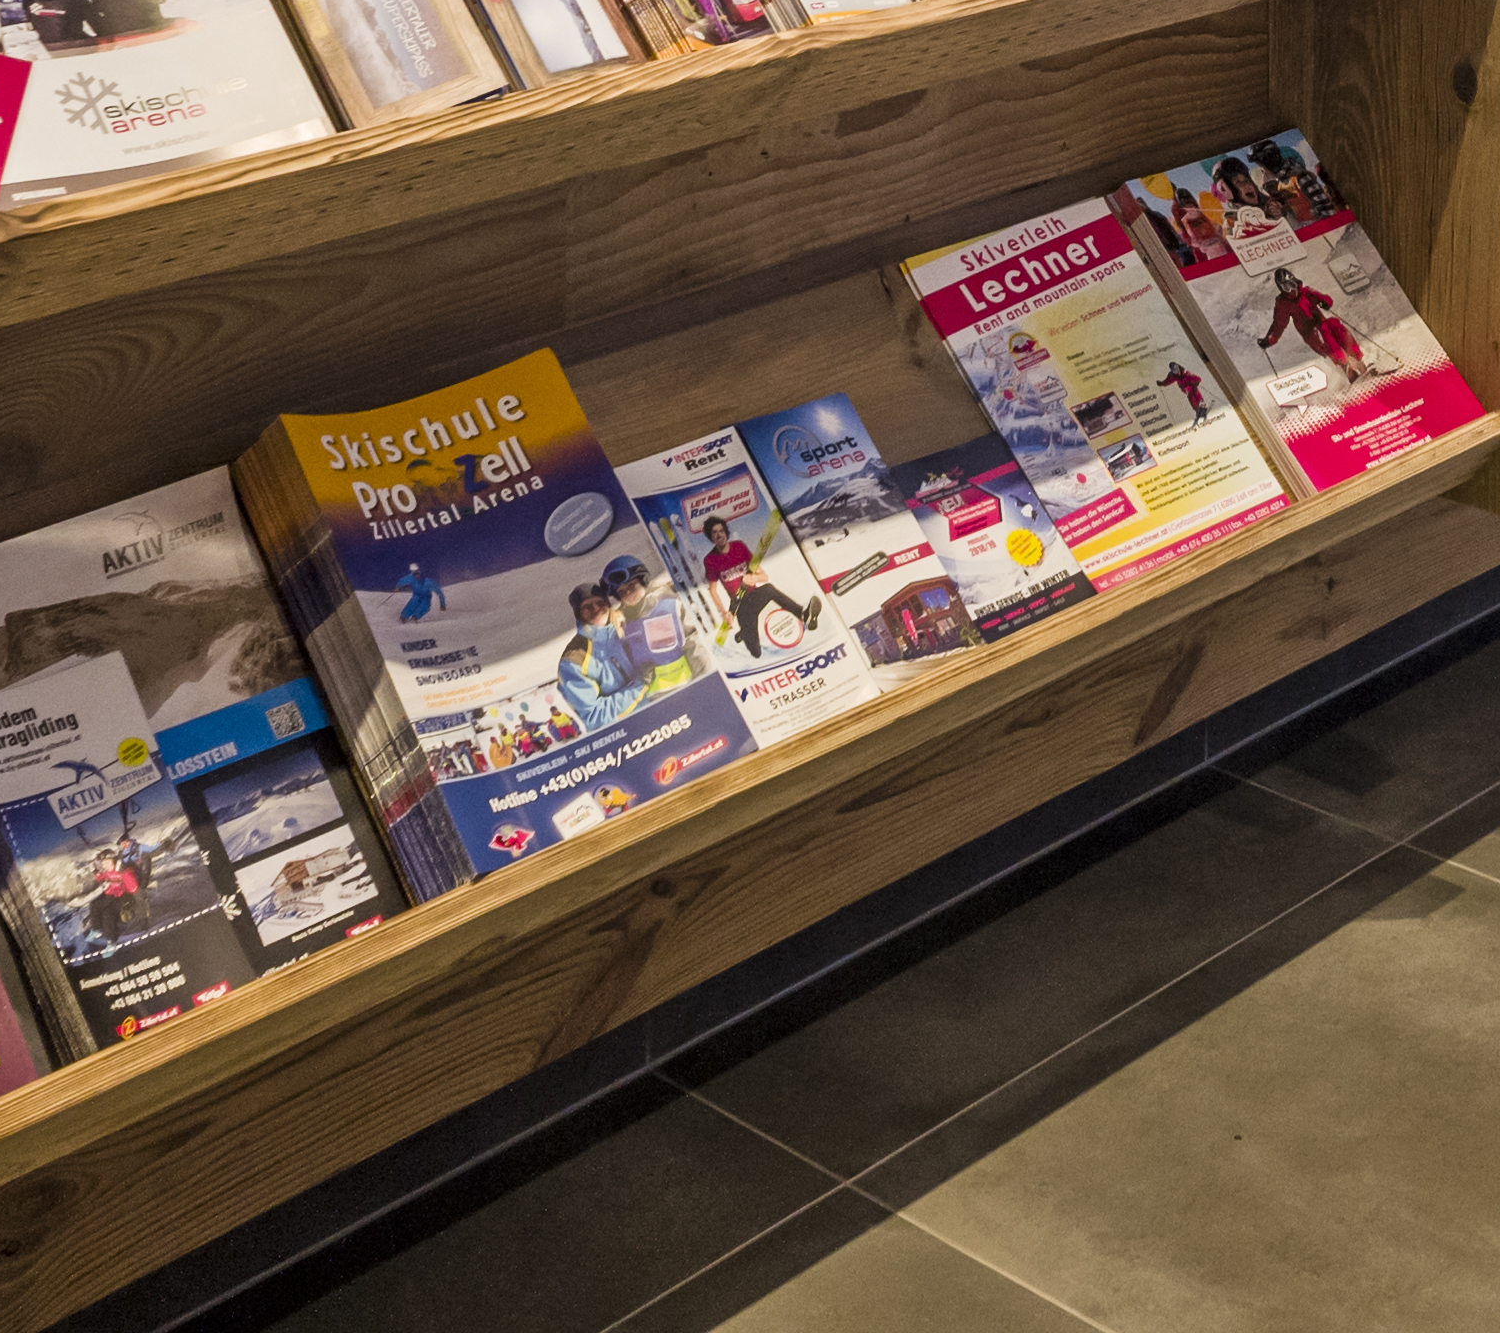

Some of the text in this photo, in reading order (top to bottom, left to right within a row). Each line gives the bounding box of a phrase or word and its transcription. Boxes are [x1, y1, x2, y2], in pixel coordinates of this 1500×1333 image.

[104, 77, 247, 118] skische
[111, 103, 207, 133] arena
[960, 217, 1067, 271] Skiverleih
[1240, 236, 1297, 263] LECHNER
[959, 235, 1100, 312] Lechner
[973, 260, 1125, 335] Rent and mountain sports
[320, 394, 525, 471] Skischule
[674, 434, 734, 463] INTERSPORT
[684, 448, 727, 471] Rent
[800, 435, 858, 463] sport
[807, 449, 865, 478] arena
[352, 436, 532, 520] Pro Zell
[369, 474, 545, 543] Zillertal Arena
[733, 499, 751, 512] YOU
[103, 511, 223, 574] AKTIV ZENTRUM
[894, 548, 920, 566] RENT
[401, 638, 437, 654] KINDER
[748, 642, 848, 700] INTERSPORT
[770, 676, 826, 710] STRASSER
[574, 744, 590, 756] SKI
[591, 728, 627, 750] RENTAL
[58, 763, 154, 815] AKTIV ZENTRUM
[489, 788, 537, 814] Hotline
